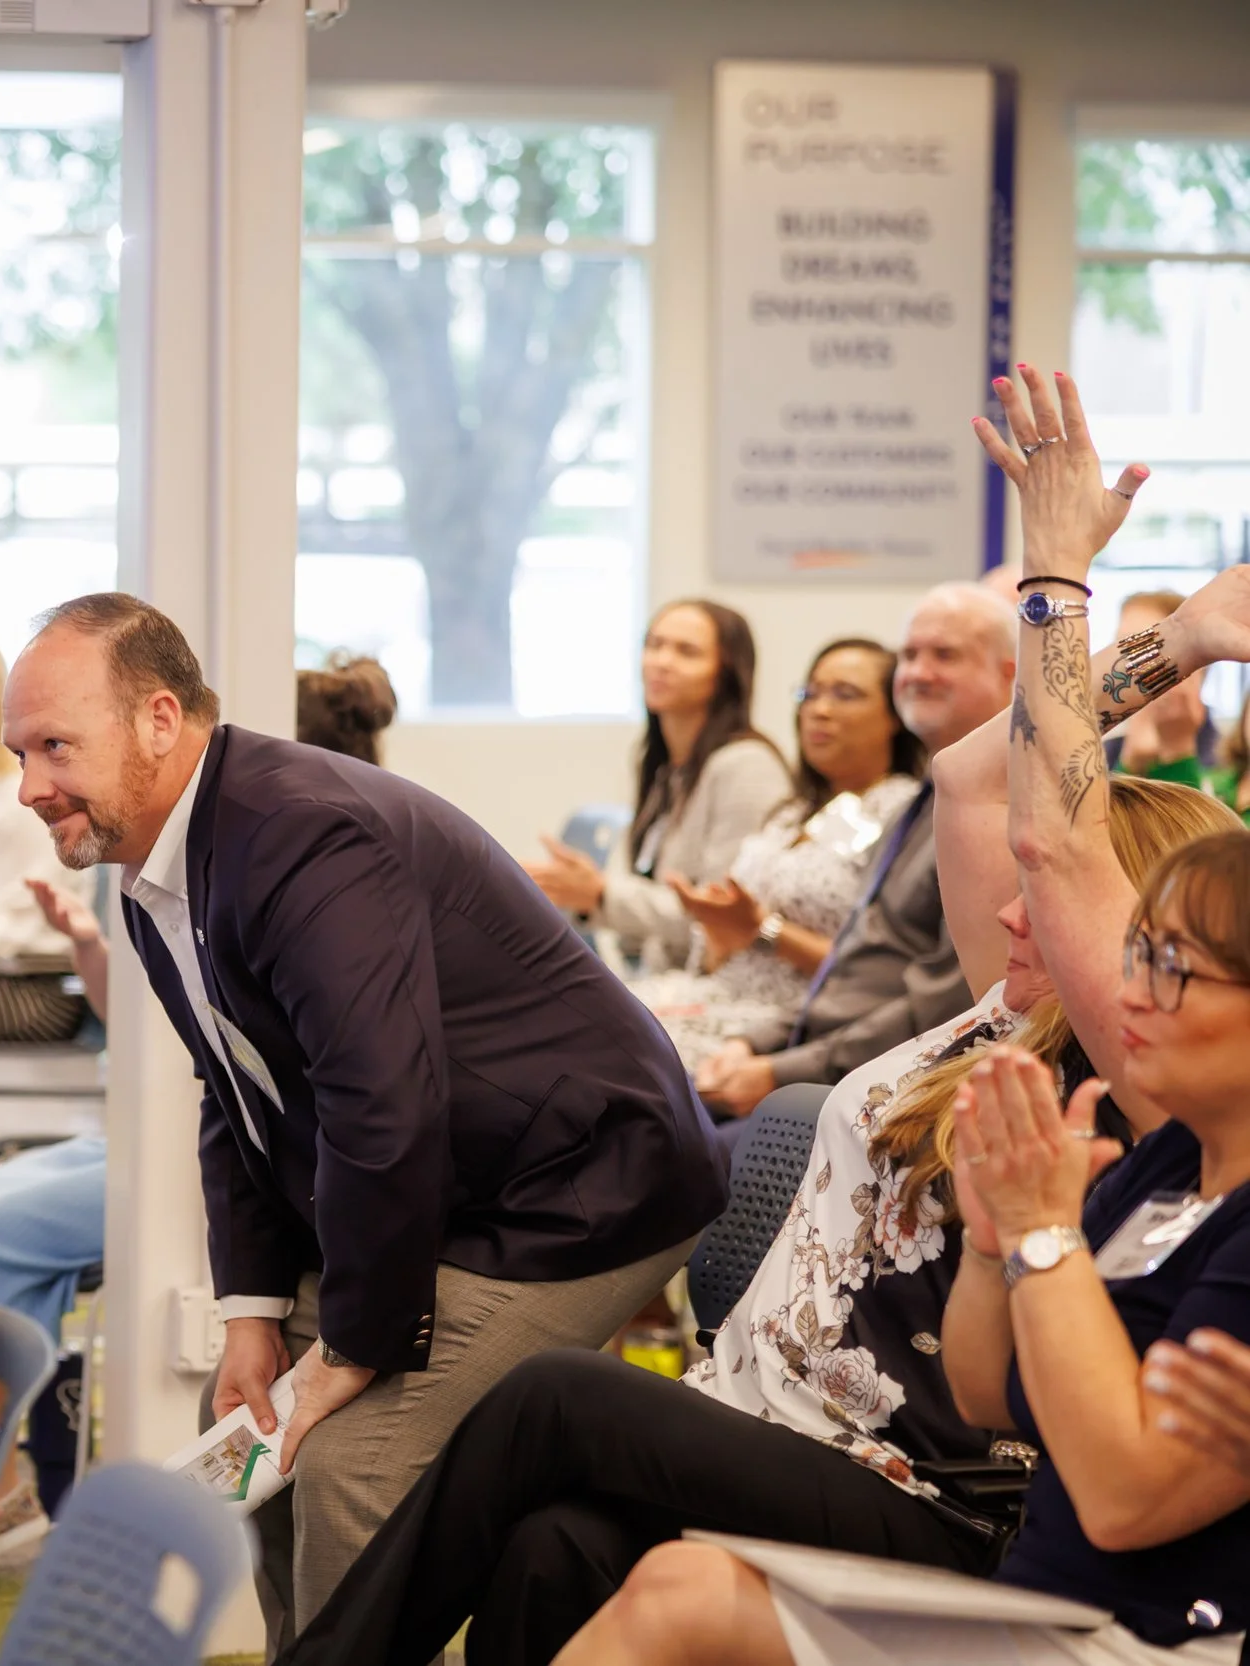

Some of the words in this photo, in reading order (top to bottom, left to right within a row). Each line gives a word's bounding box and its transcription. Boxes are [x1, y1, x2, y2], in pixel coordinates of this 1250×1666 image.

[745, 92, 839, 127] OUR
[746, 137, 952, 172] PURPOSE
[777, 209, 933, 242] BUILDING
[751, 294, 955, 325] ENHANCING
[813, 337, 895, 367] LIVES
[782, 406, 840, 430] OUR
[742, 442, 797, 466] OUR
[735, 478, 791, 503] OUR
